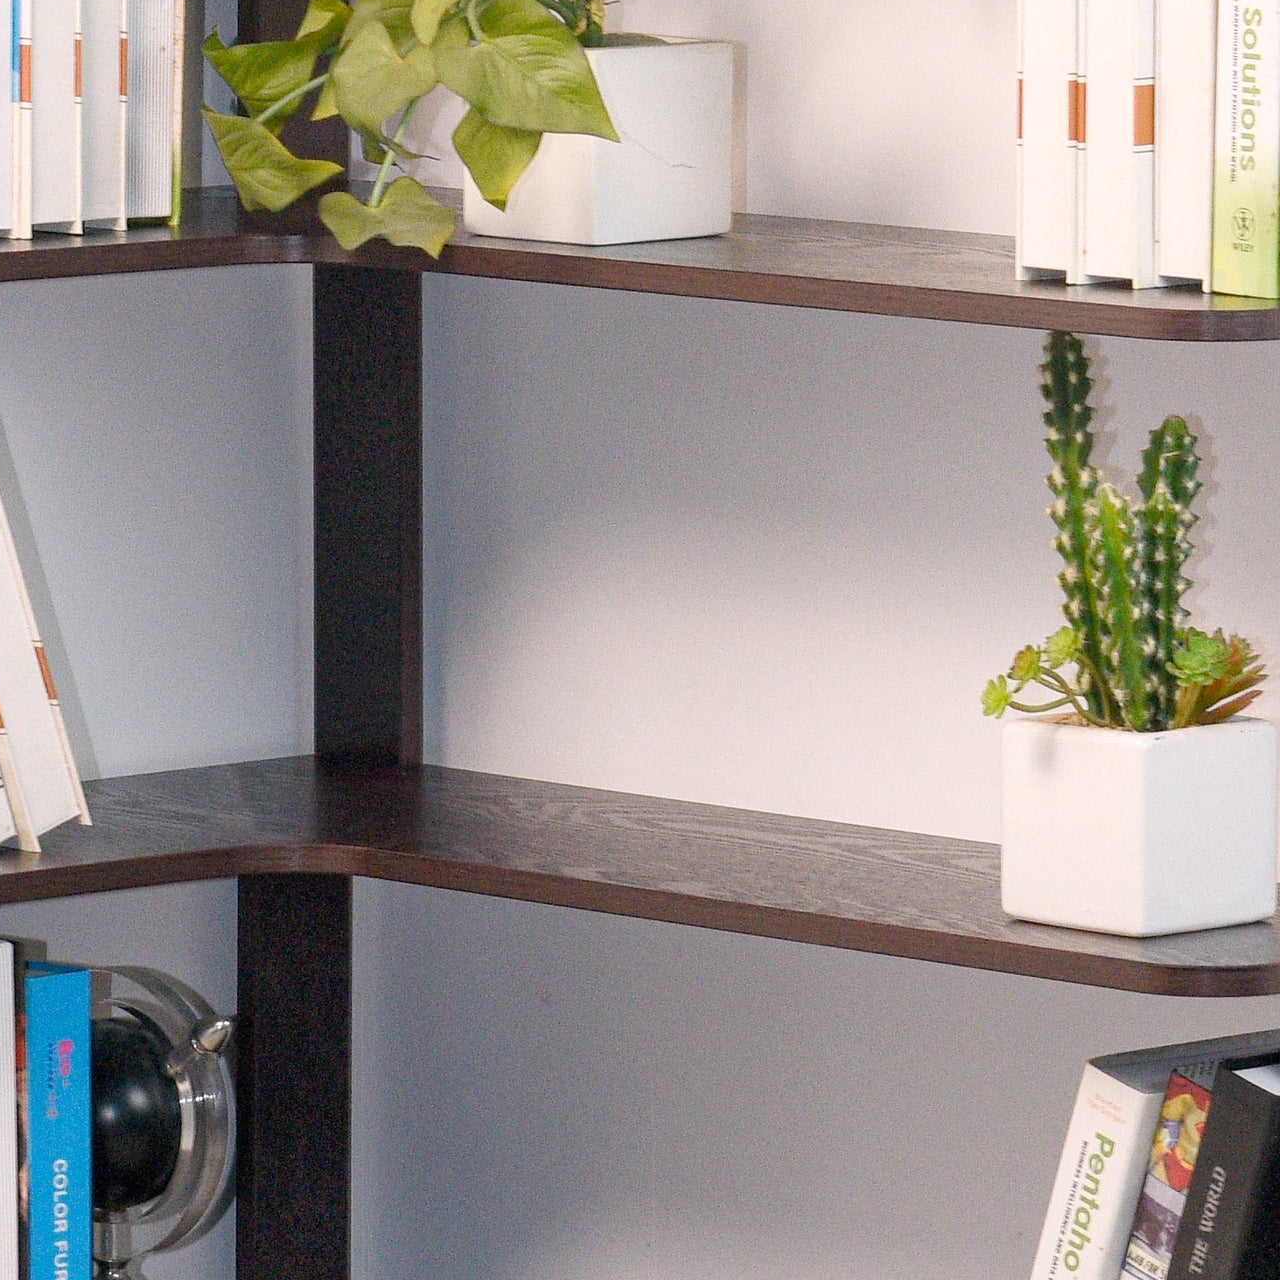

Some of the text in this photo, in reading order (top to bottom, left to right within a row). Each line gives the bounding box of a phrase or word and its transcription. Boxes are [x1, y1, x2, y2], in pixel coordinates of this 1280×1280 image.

[1240, 7, 1262, 172] Solutions
[53, 1158, 69, 1233] COLOR
[1064, 1131, 1116, 1272] Pentaho
[1188, 1238, 1209, 1274] THE
[1199, 1166, 1227, 1233] WORLD
